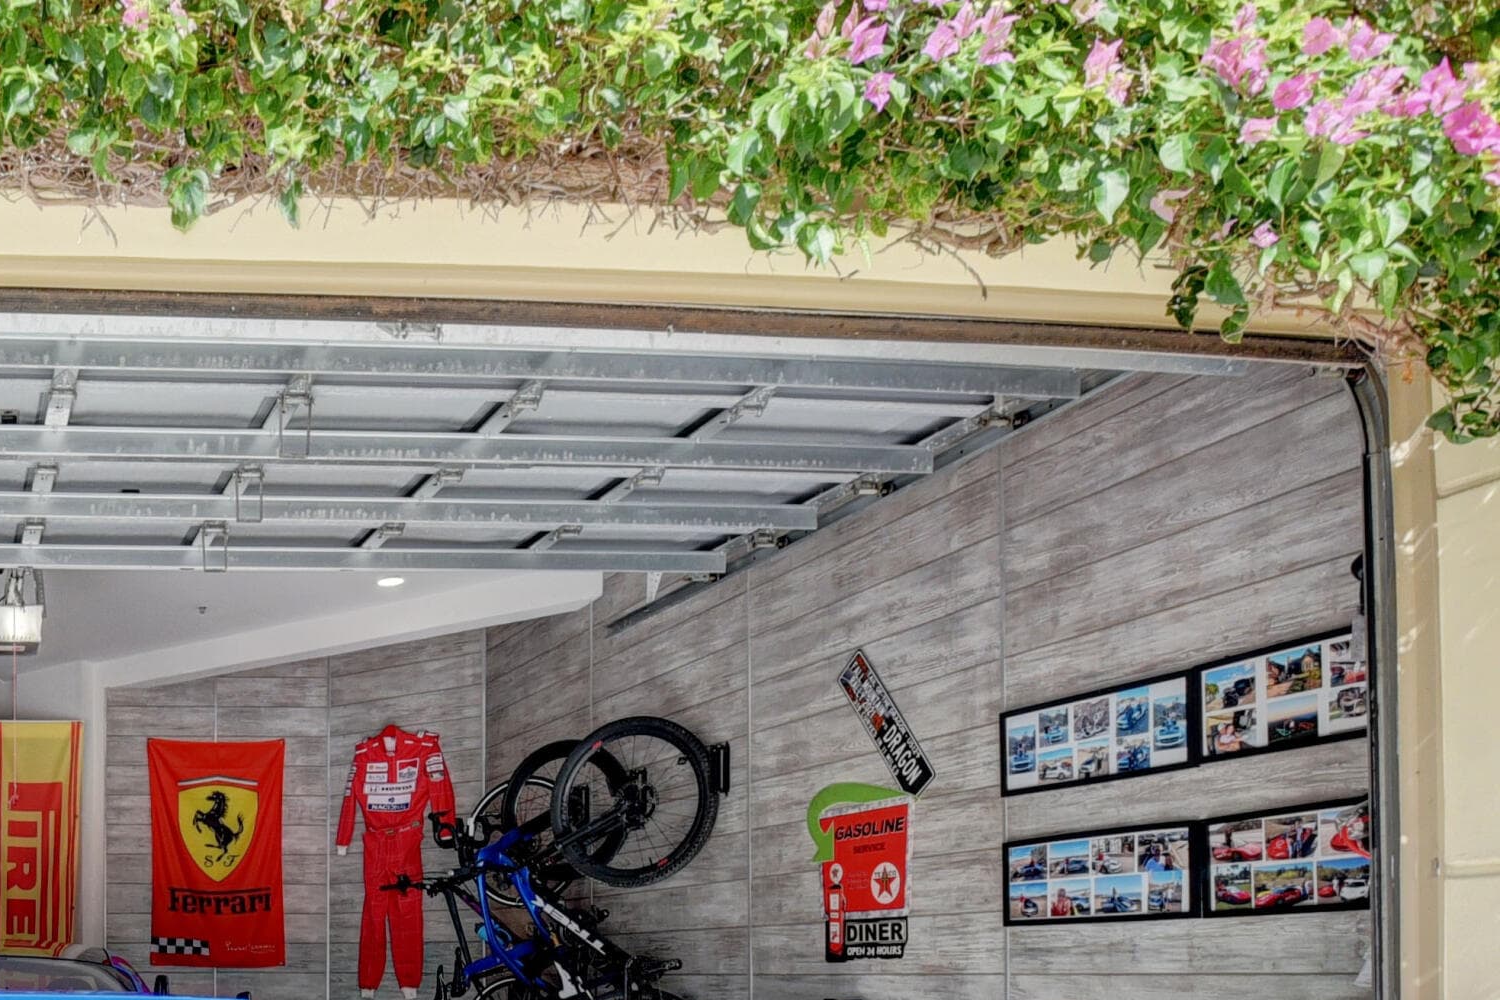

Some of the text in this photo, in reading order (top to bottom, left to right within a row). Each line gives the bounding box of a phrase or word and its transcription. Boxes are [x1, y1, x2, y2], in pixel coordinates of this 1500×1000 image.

[882, 724, 922, 787] DRAGON
[835, 816, 904, 841] GASOLINE
[853, 842, 886, 855] SERVICE
[4, 782, 63, 950] PIRE
[168, 886, 271, 915] Ferrari
[530, 893, 607, 956] TREK
[847, 922, 903, 942] DINER
[847, 946, 866, 957] OPEN
[875, 945, 902, 956] HOURS
